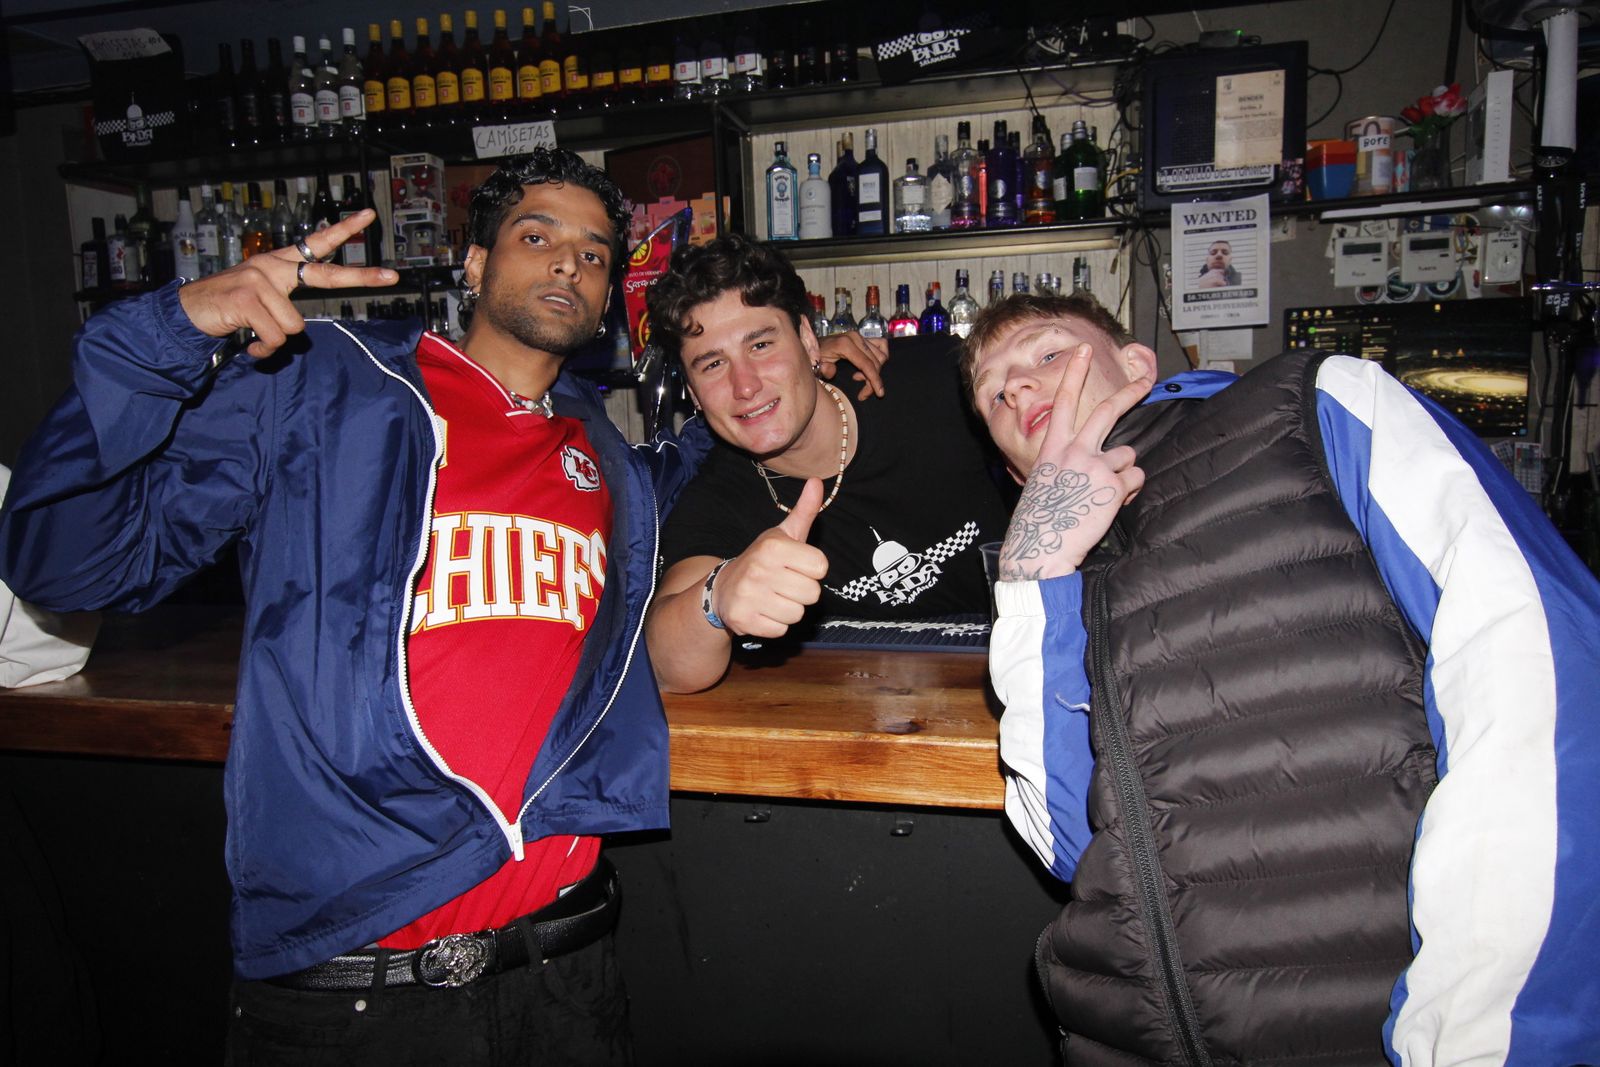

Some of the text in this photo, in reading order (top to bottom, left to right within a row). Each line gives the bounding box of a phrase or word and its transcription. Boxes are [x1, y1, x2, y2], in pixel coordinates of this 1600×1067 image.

[475, 124, 550, 150] CAMISETAS
[1363, 136, 1389, 148] BOTE
[1183, 208, 1257, 227] WANTED
[410, 511, 608, 635] HIEF
[890, 576, 938, 607] SAAMANCA
